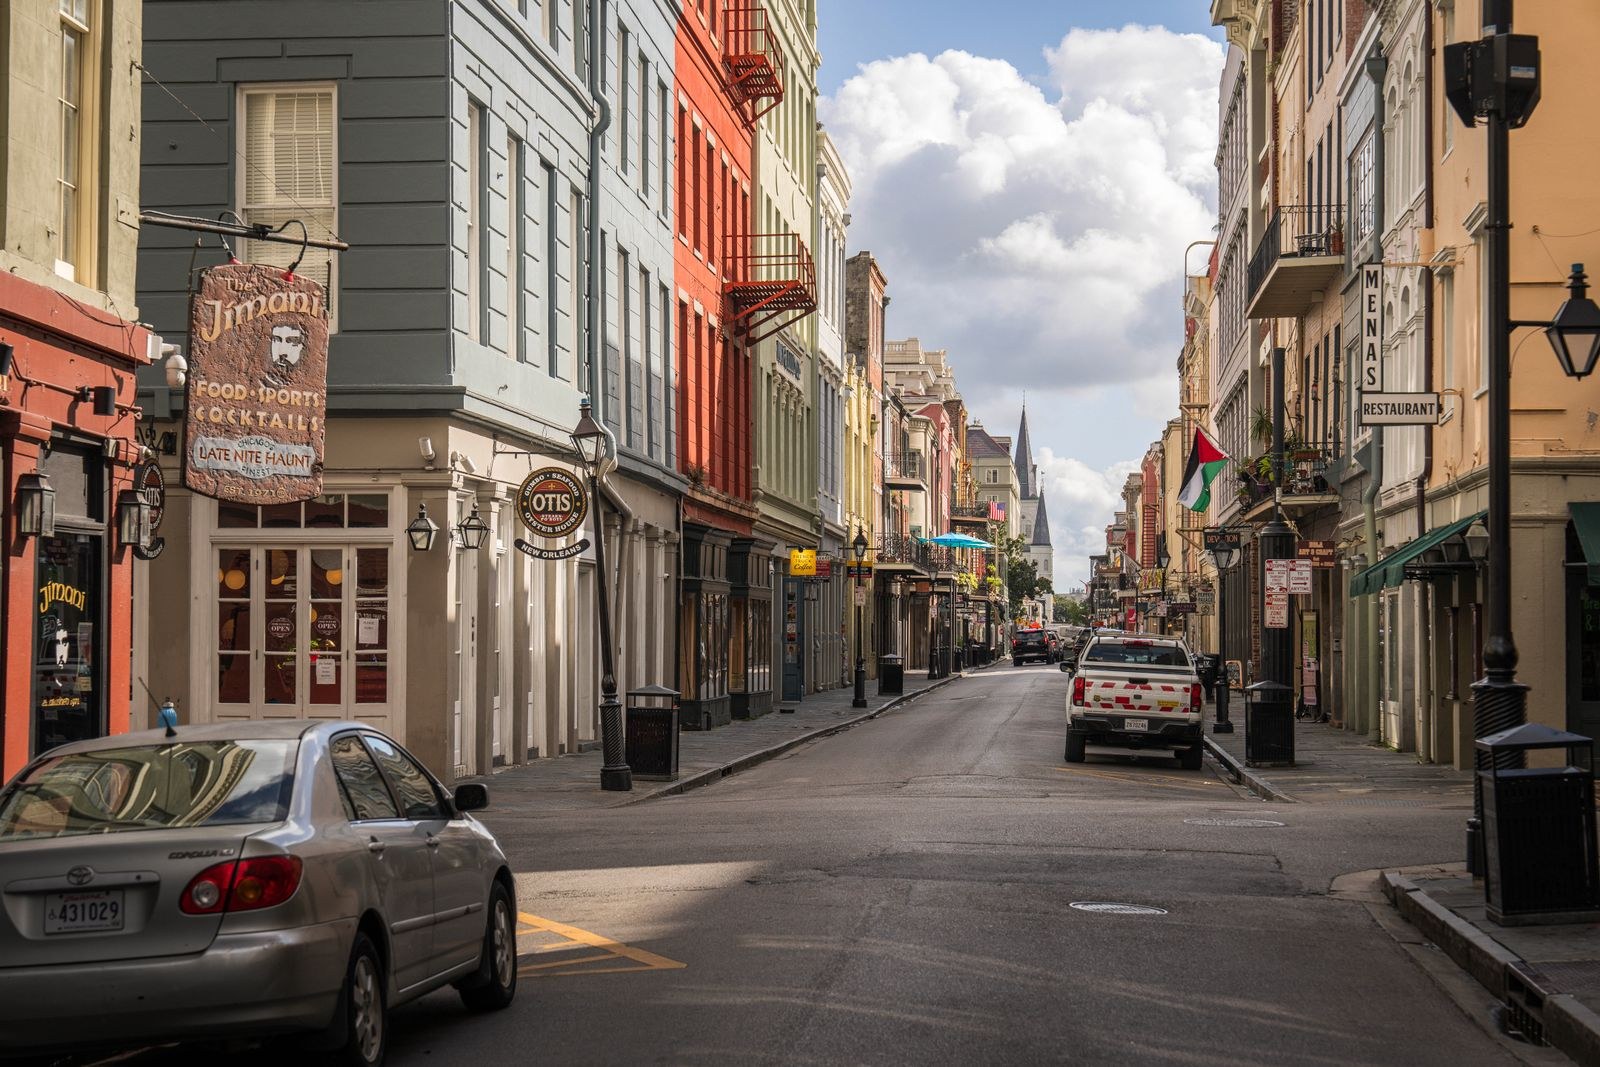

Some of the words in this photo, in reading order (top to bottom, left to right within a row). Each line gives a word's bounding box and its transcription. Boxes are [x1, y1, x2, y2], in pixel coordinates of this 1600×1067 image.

[225, 278, 253, 291] The
[200, 290, 321, 341] Jimani
[1365, 269, 1379, 386] MENAS
[196, 380, 248, 400] FOOD
[258, 386, 320, 408] SPORTS
[194, 405, 319, 432] COCKTAILS
[1363, 402, 1435, 416] RESTAURANT
[199, 446, 231, 461] LATE
[233, 450, 262, 465] NITE
[265, 452, 312, 468] HAUNT
[241, 466, 271, 476] FINEST
[524, 474, 545, 497] GUMBO
[551, 472, 580, 497] SEAFOOD
[144, 487, 160, 506] OTIS
[532, 493, 571, 512] OTIS
[524, 512, 554, 533] OYSTER
[555, 511, 579, 533] HOUSE
[520, 543, 540, 557] NEW
[542, 544, 582, 559] ORLEANS
[793, 563, 813, 571] Coffee
[39, 581, 86, 613] Jimani
[168, 849, 218, 859] COROLLA
[59, 901, 119, 923] 431029
